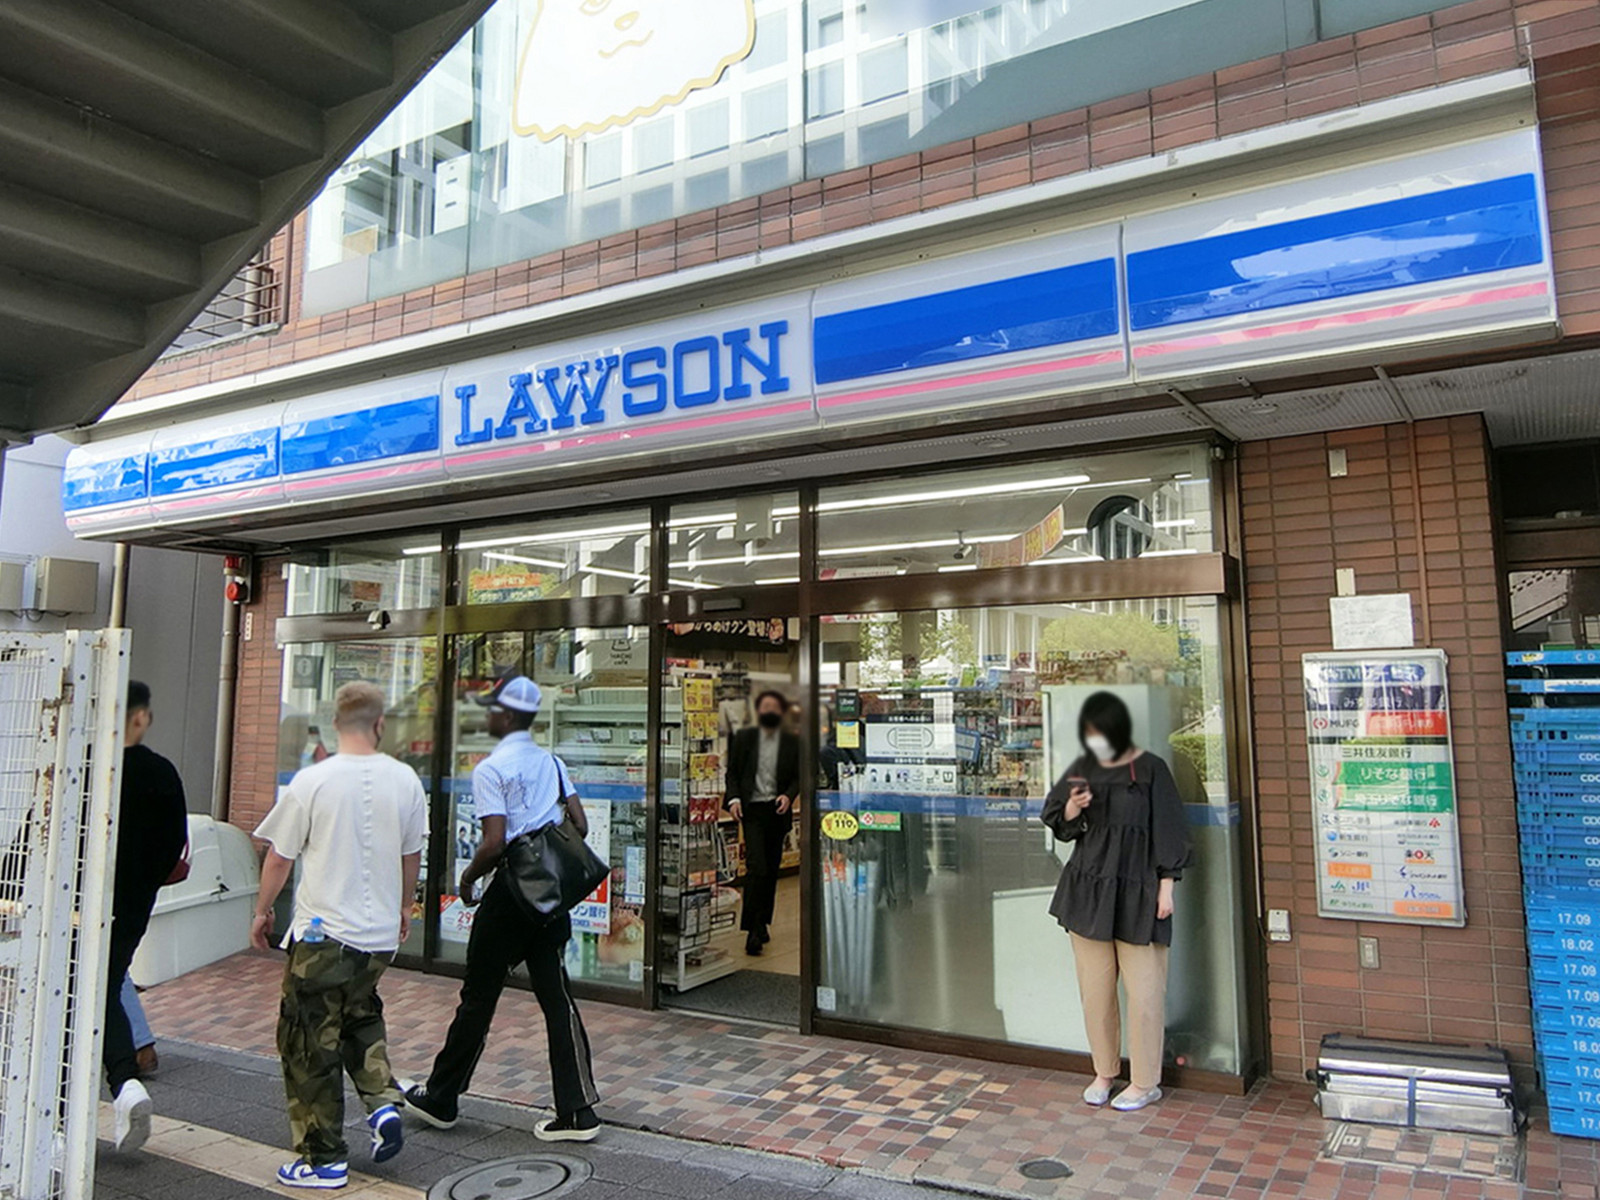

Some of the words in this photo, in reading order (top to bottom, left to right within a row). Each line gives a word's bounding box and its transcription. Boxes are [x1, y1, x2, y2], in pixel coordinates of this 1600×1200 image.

[455, 320, 789, 446] LAWSON
[1330, 718, 1359, 728] MUFG
[1341, 747, 1412, 759] 三井住友銀行
[1360, 766, 1426, 780] りそな銀行
[1558, 913, 1591, 926] 17.09
[1561, 939, 1594, 952] 18.02
[1566, 989, 1600, 1003] 17.09
[1573, 1040, 1600, 1054] 18.0
